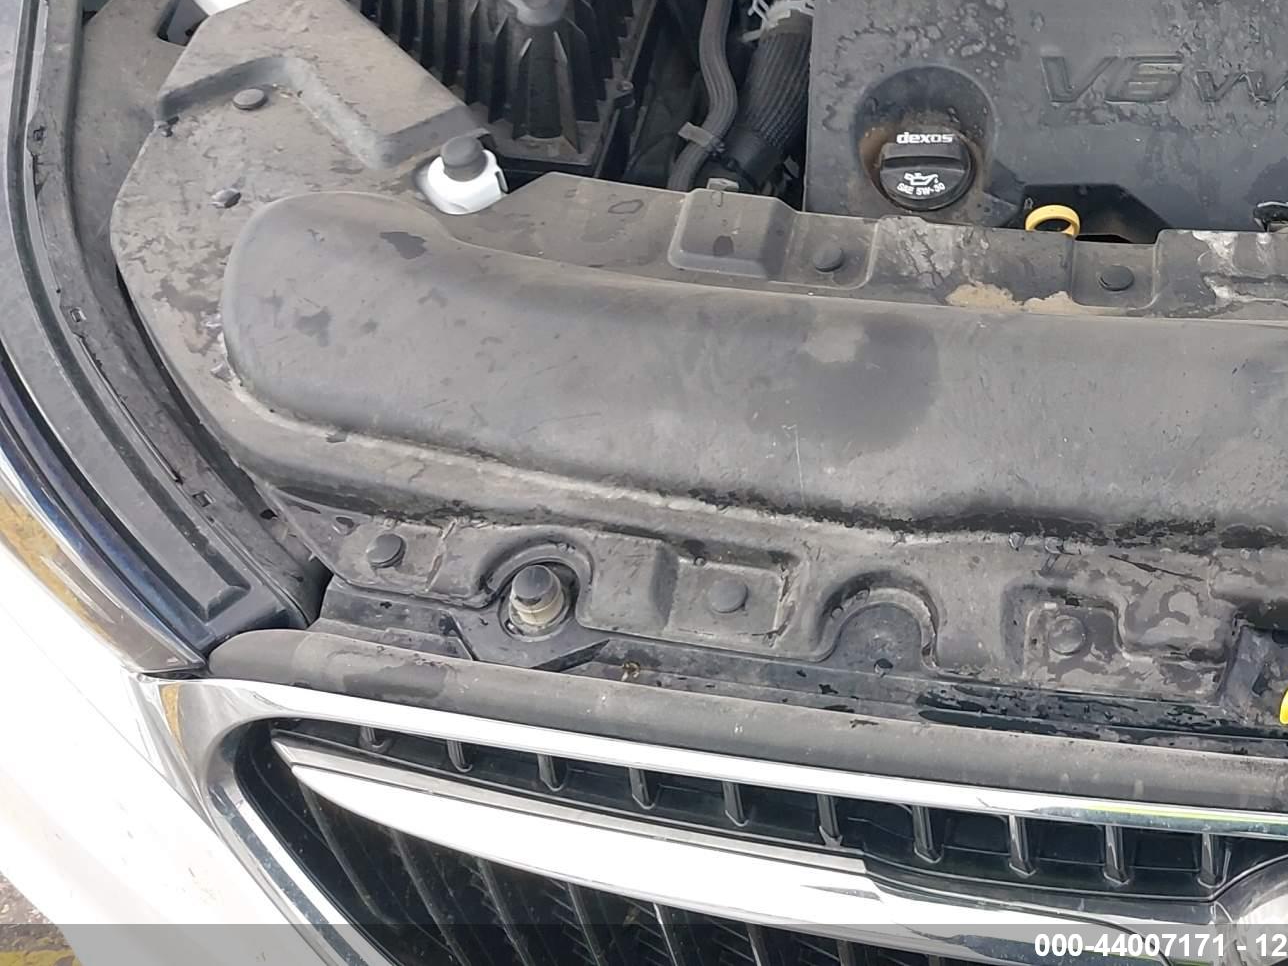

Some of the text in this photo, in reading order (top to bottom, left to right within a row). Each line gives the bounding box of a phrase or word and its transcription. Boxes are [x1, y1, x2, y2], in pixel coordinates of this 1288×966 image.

[1040, 56, 1184, 103] V6
[896, 132, 954, 144] dexos
[896, 182, 946, 196] SAE 5W-30
